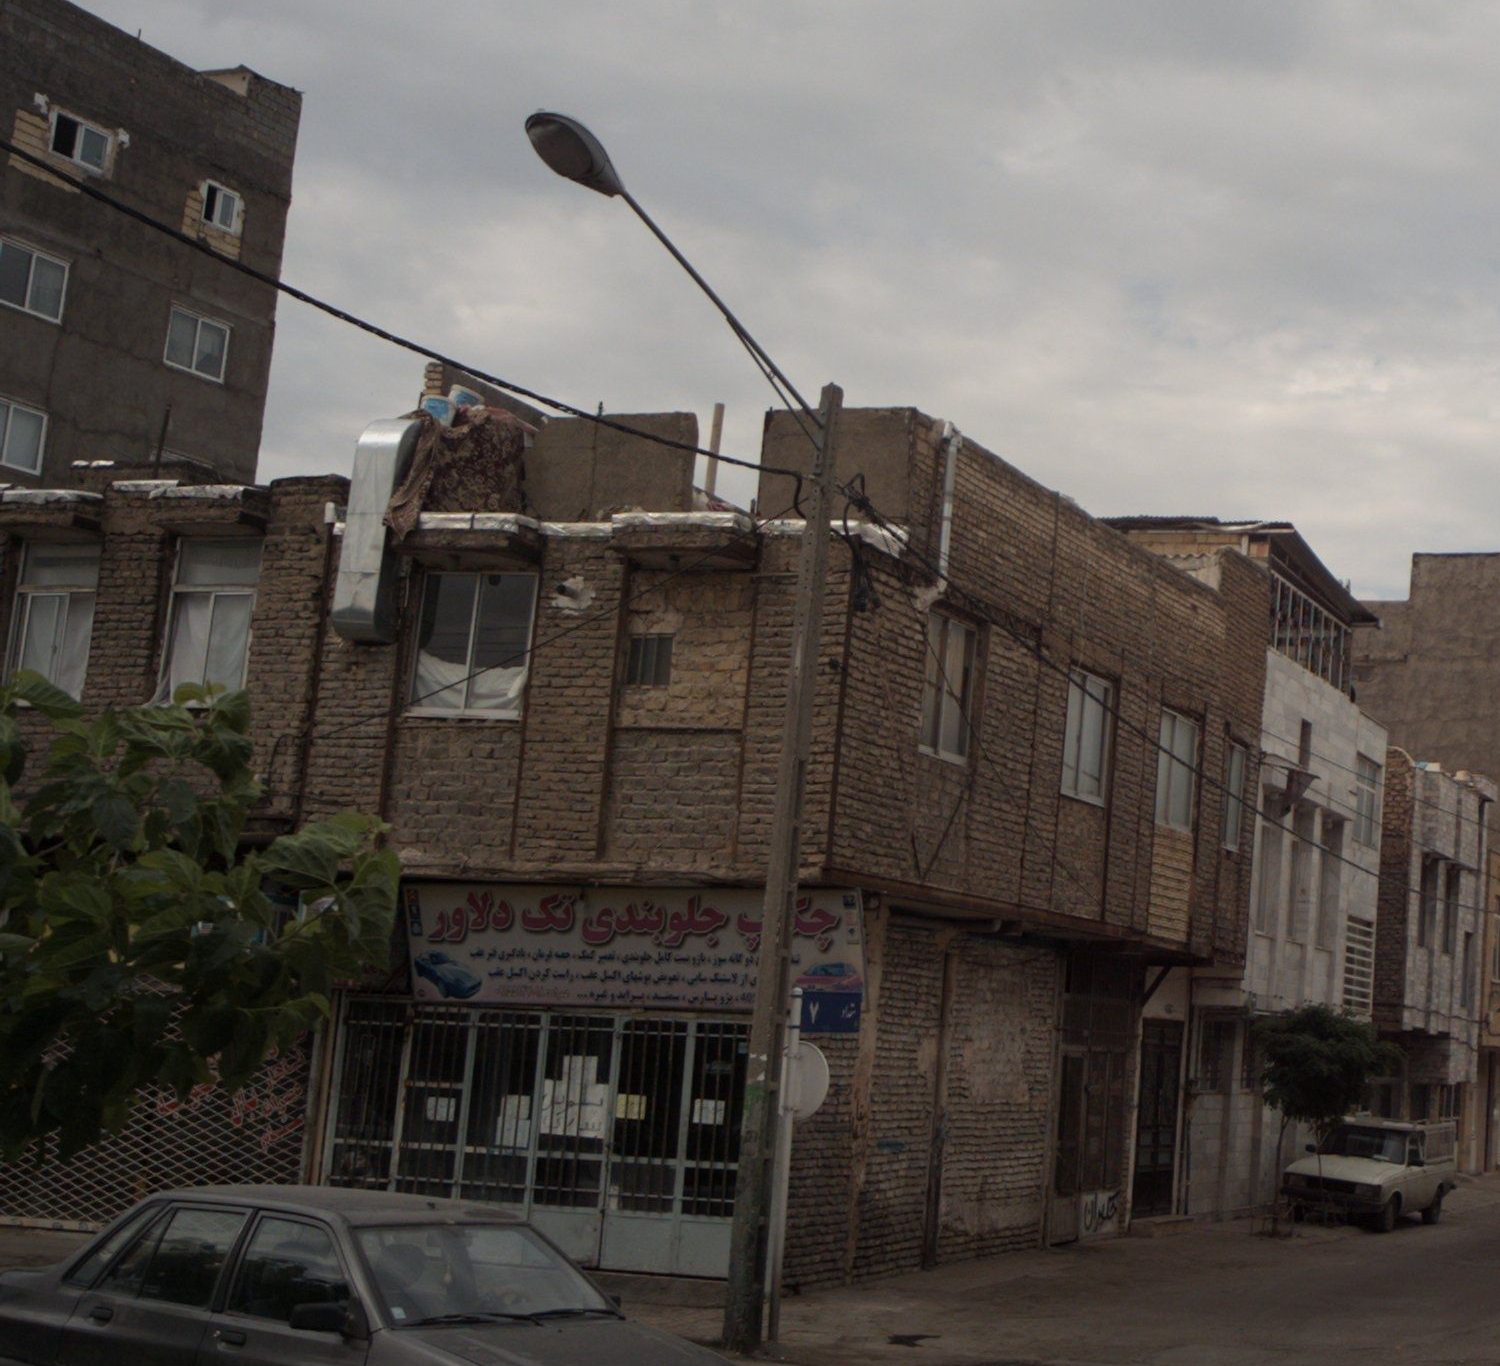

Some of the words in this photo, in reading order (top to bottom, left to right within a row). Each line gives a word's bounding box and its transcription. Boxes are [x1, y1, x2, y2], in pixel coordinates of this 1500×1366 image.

[427, 889, 515, 943] دلاور
[521, 892, 576, 932] تک
[581, 893, 728, 947] جلوبندی
